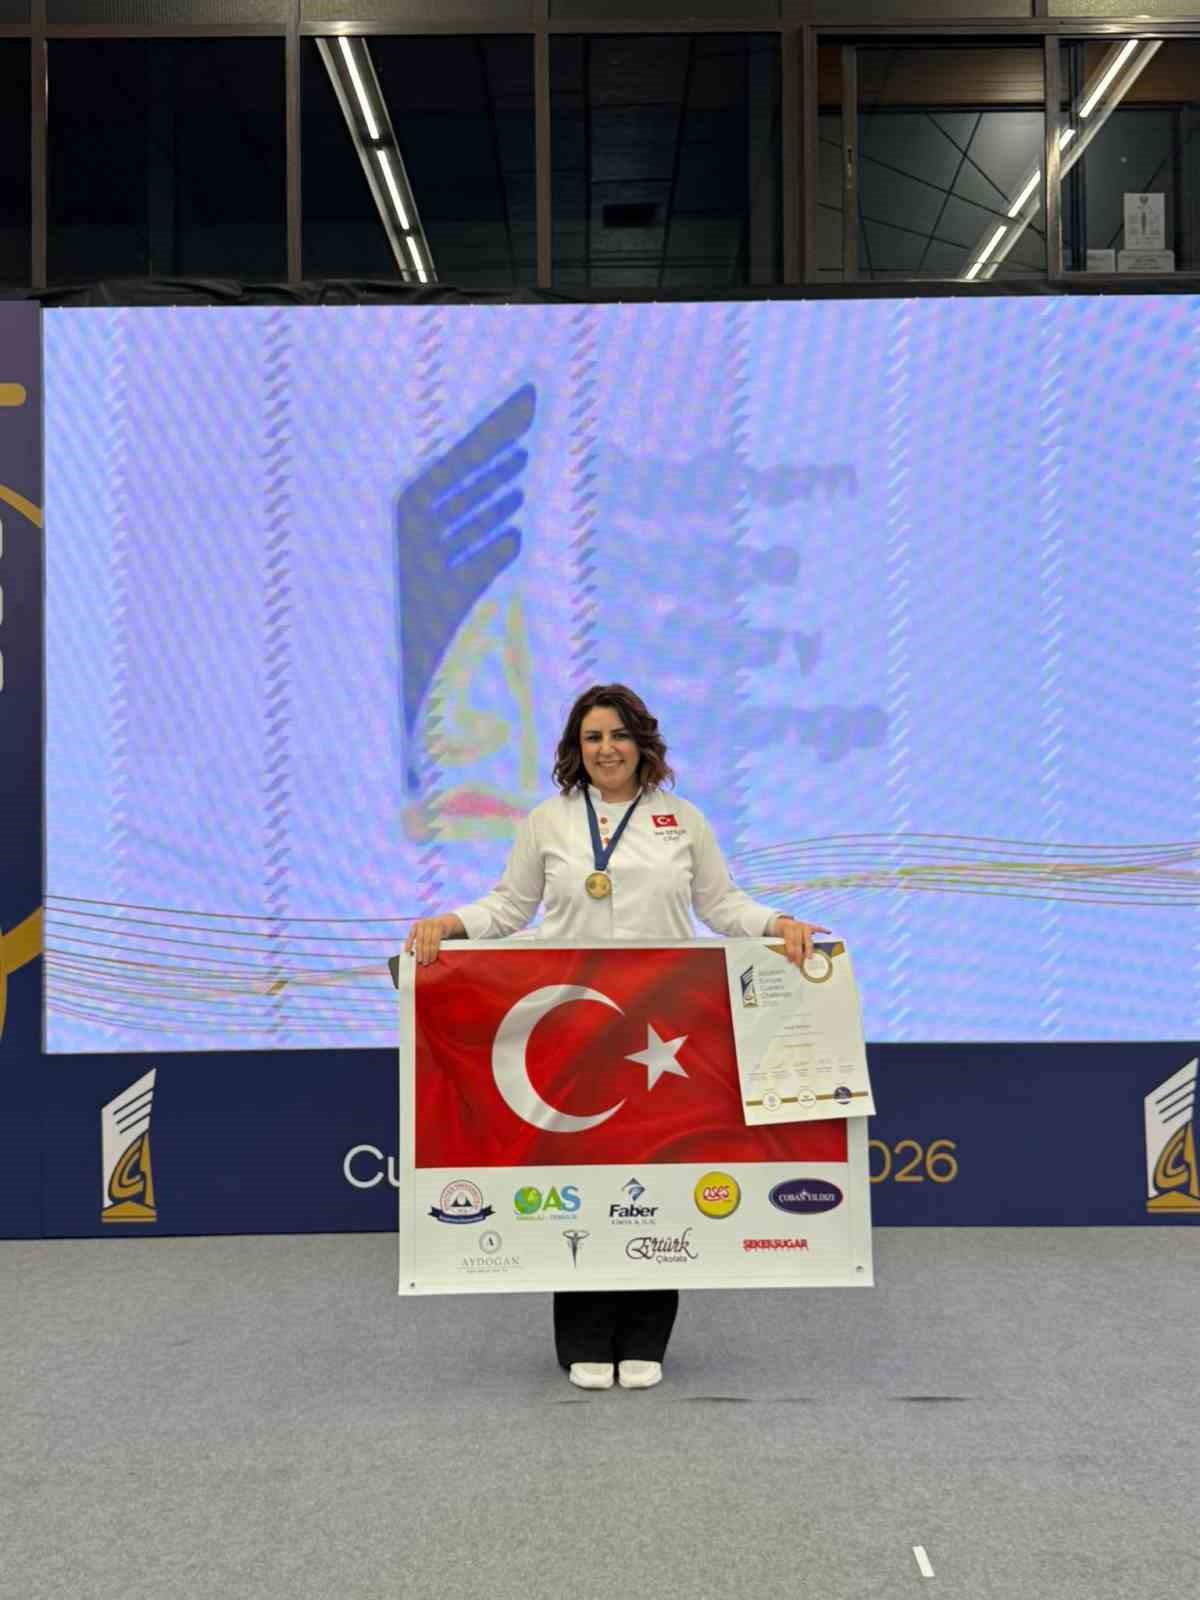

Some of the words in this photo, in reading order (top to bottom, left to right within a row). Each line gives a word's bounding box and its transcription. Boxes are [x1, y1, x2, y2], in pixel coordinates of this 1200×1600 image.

[344, 1144, 400, 1189] Cu
[868, 1139, 958, 1184] 026
[609, 1204, 658, 1217] Faber
